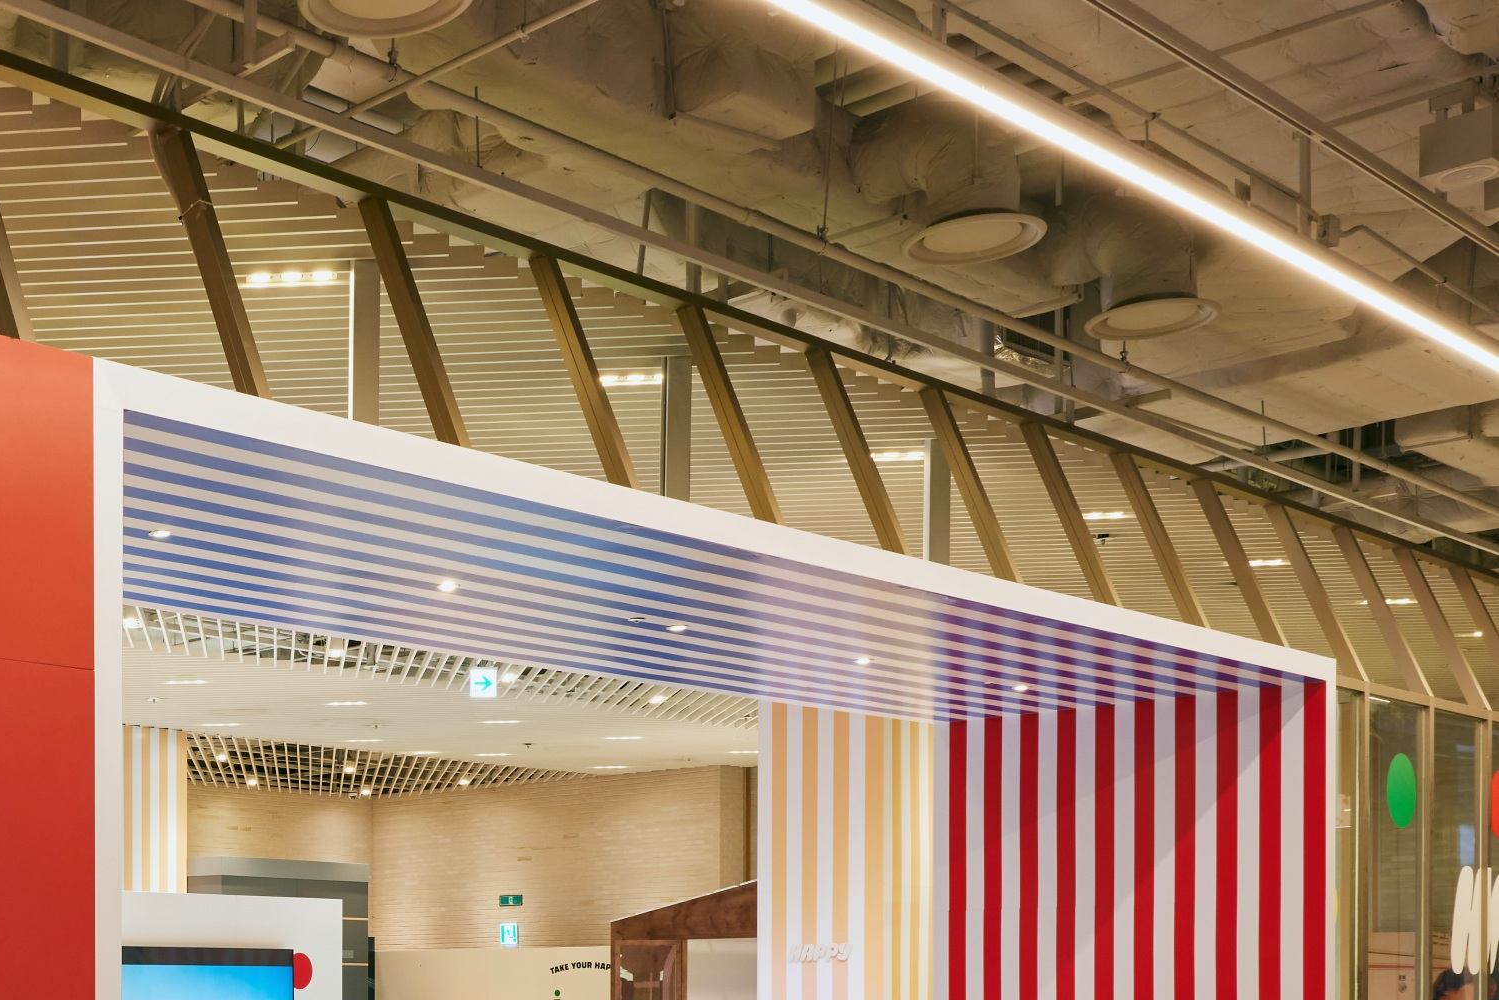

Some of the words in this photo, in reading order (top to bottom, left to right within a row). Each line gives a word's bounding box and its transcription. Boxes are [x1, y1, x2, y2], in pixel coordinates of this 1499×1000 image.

[1451, 865, 1499, 975] H
[789, 943, 852, 962] HAPPY
[550, 963, 569, 974] TAKE
[571, 961, 592, 970] YOUR
